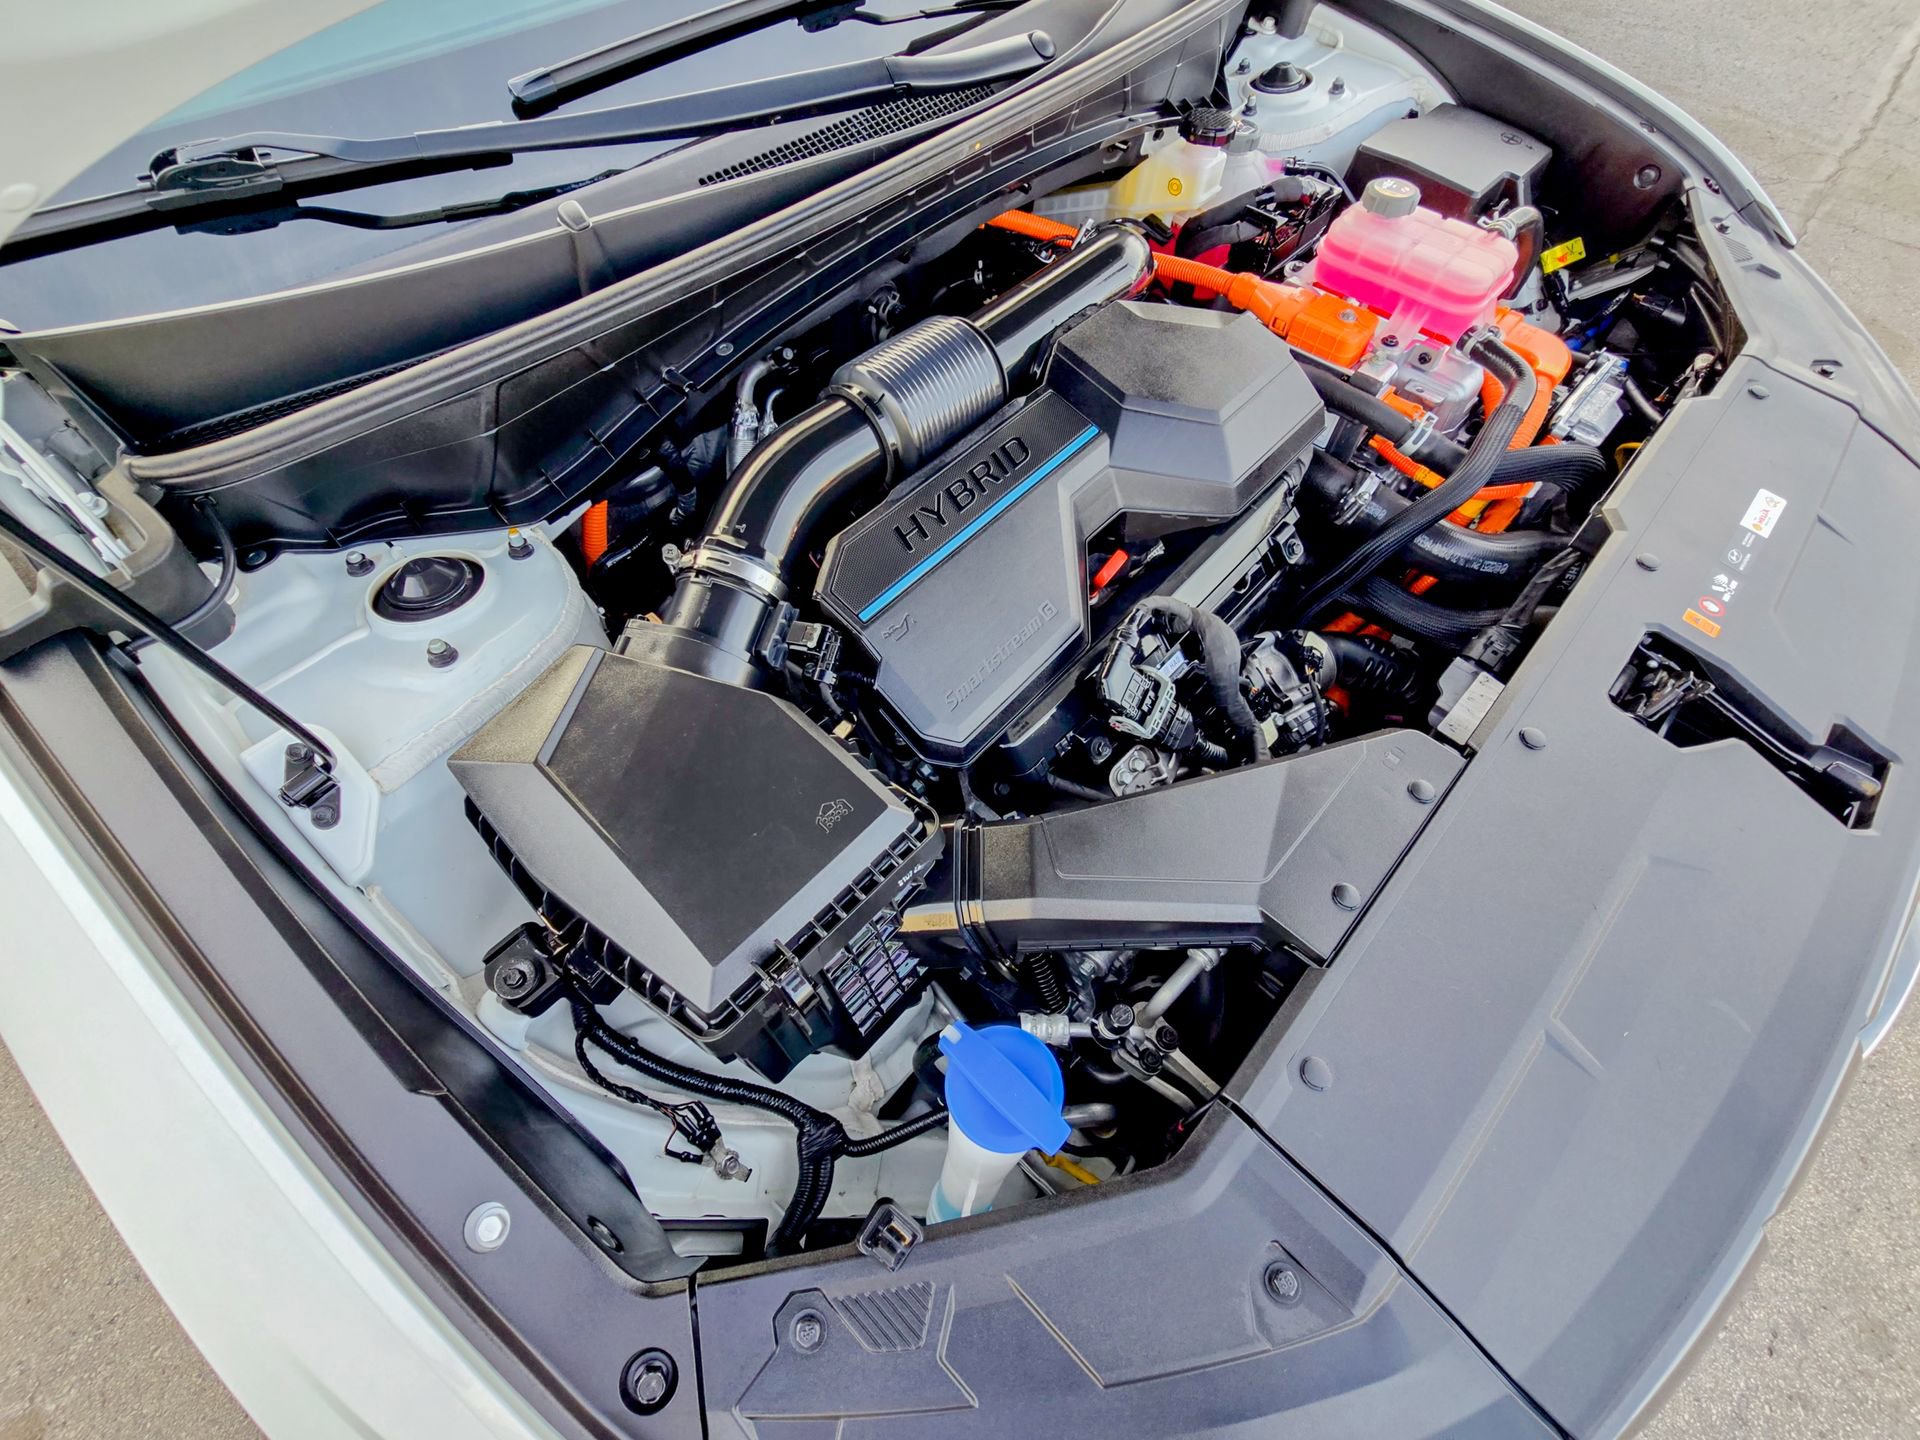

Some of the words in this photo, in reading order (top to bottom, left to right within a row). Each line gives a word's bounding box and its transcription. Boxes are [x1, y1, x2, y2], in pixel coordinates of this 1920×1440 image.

[893, 437, 1031, 553] HYBRID
[945, 616, 1044, 713] Smartstream
[1038, 600, 1059, 622] G
